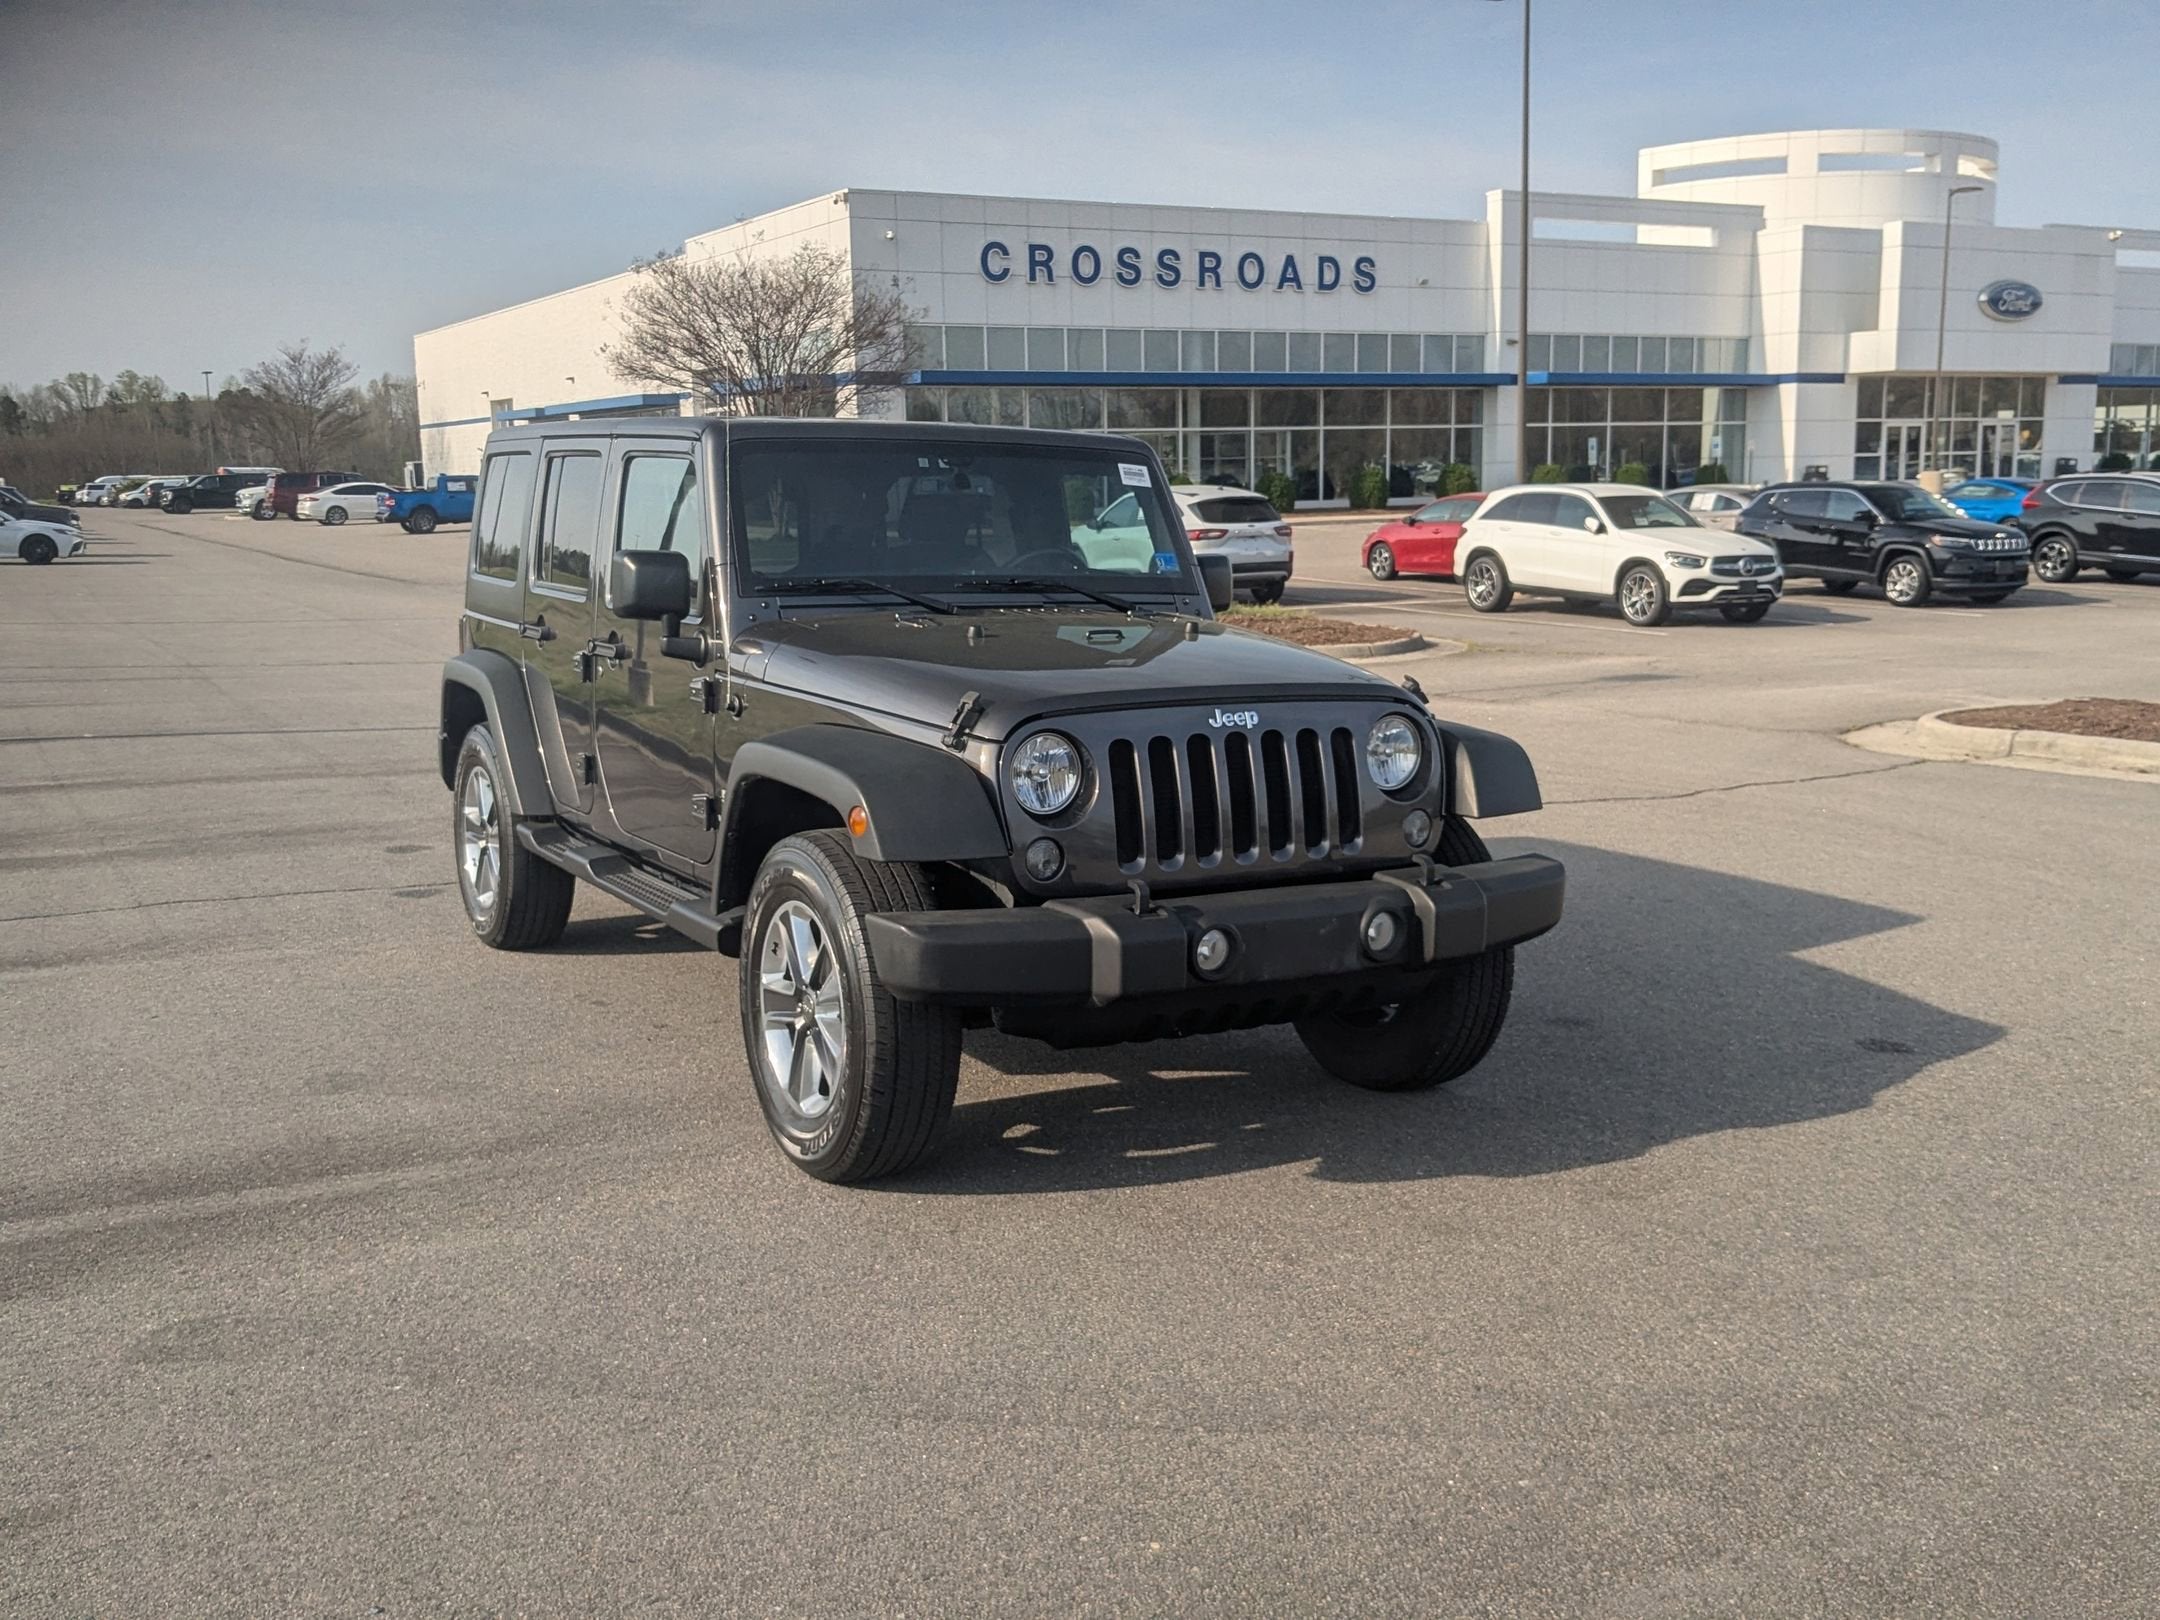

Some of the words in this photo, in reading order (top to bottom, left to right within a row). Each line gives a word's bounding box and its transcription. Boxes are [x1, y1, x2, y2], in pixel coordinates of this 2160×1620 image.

[980, 240, 1378, 295] CROSSROADS
[1998, 288, 2034, 312] Ford
[1208, 708, 1259, 730] Jeep
